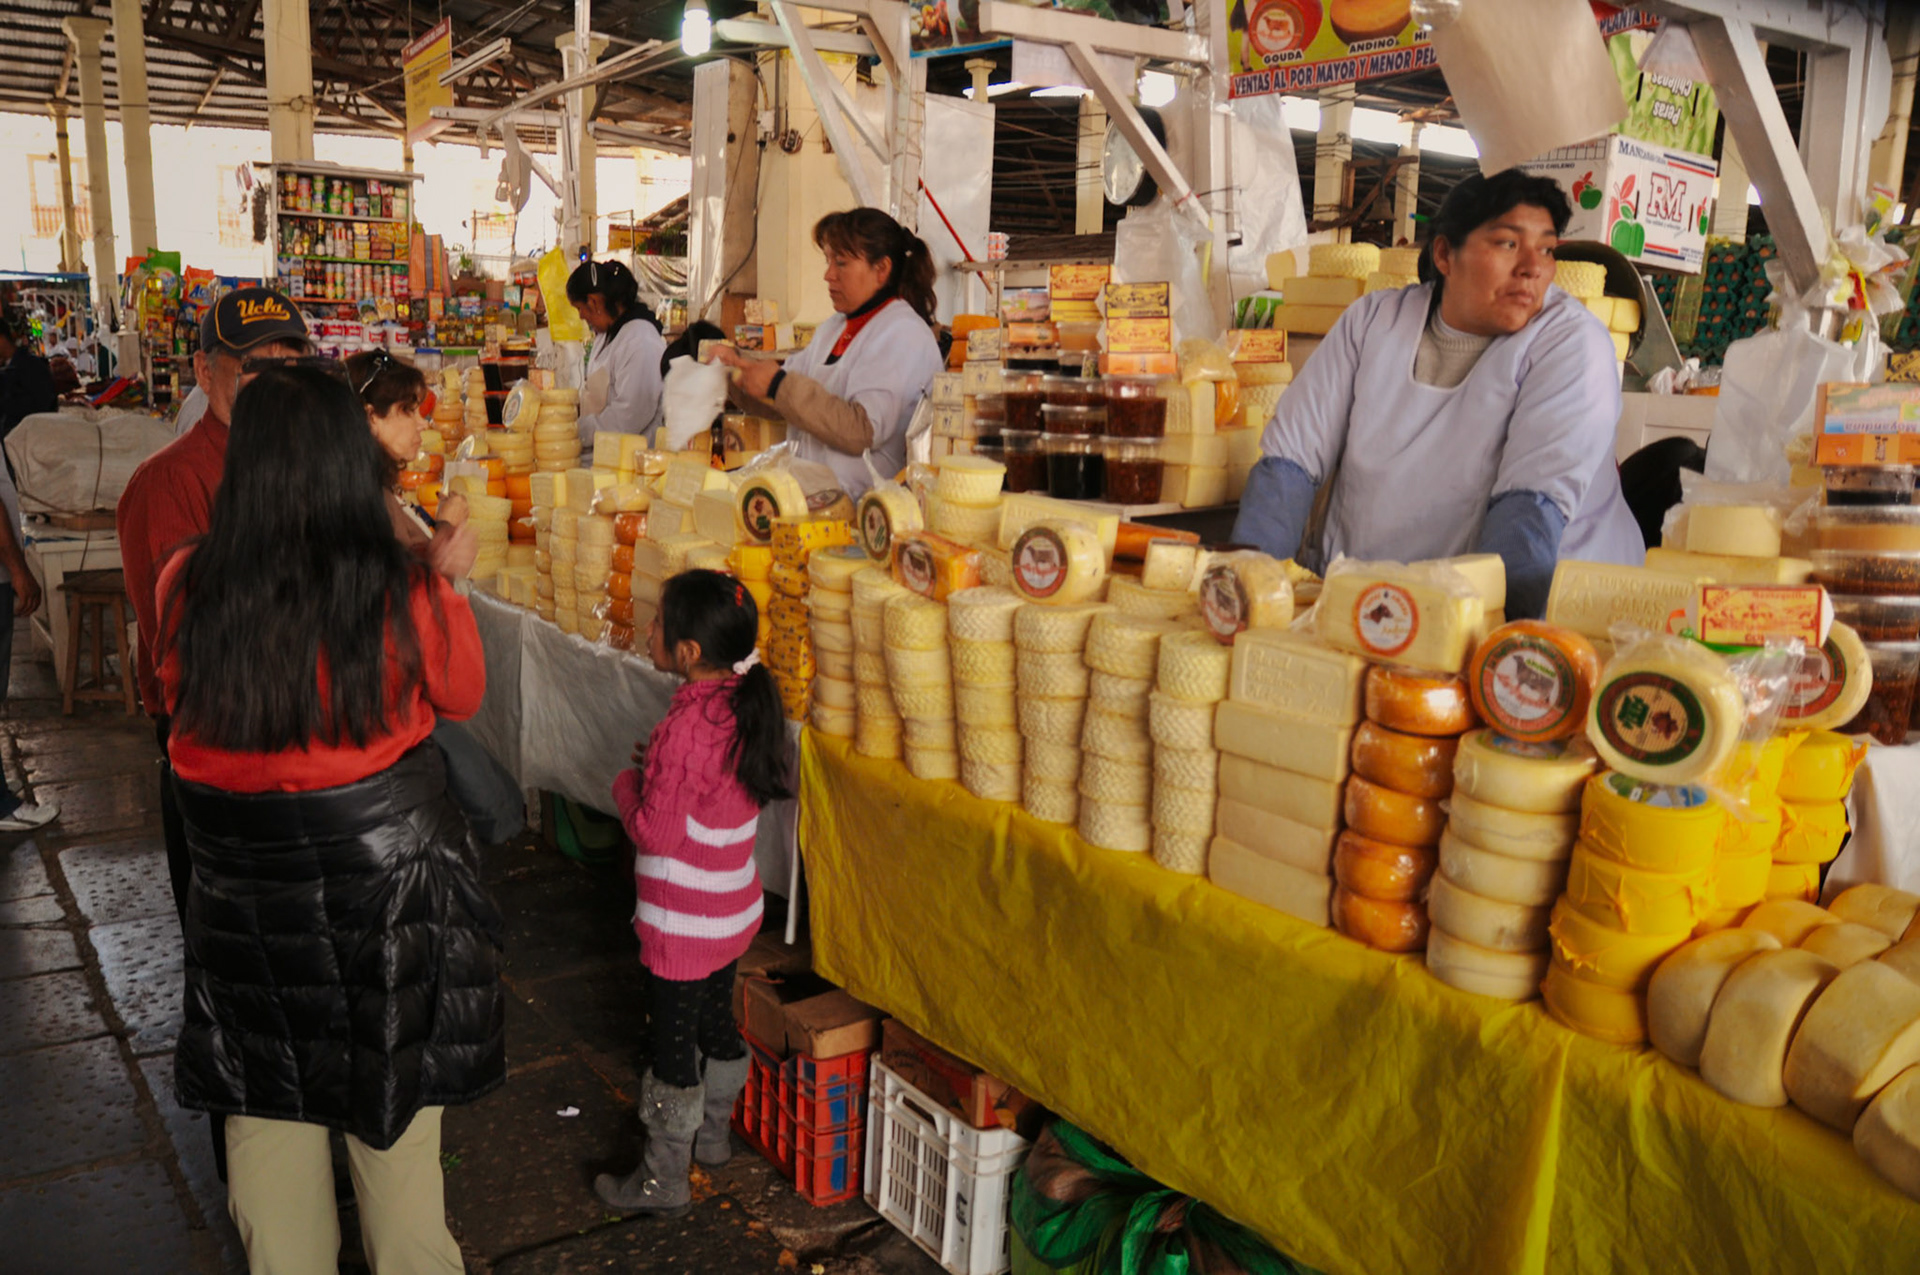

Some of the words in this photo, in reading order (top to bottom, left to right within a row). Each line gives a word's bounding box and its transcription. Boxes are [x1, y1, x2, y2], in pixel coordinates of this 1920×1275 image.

[1263, 50, 1303, 65] GOUDA
[1349, 38, 1396, 54] ANDINO
[1234, 73, 1271, 96] VENTAS
[1273, 72, 1287, 91] AL
[1290, 67, 1313, 88] POR
[1316, 62, 1356, 85] MAYOR
[1358, 58, 1367, 76] Y
[1368, 49, 1412, 74] MENOR
[1652, 73, 1693, 97] Chilenas
[1652, 100, 1683, 126] Peras
[1545, 162, 1576, 170] CHILENO
[1646, 171, 1687, 223] RM
[237, 296, 289, 321] Ucla
[1752, 590, 1807, 601] Mantequilla
